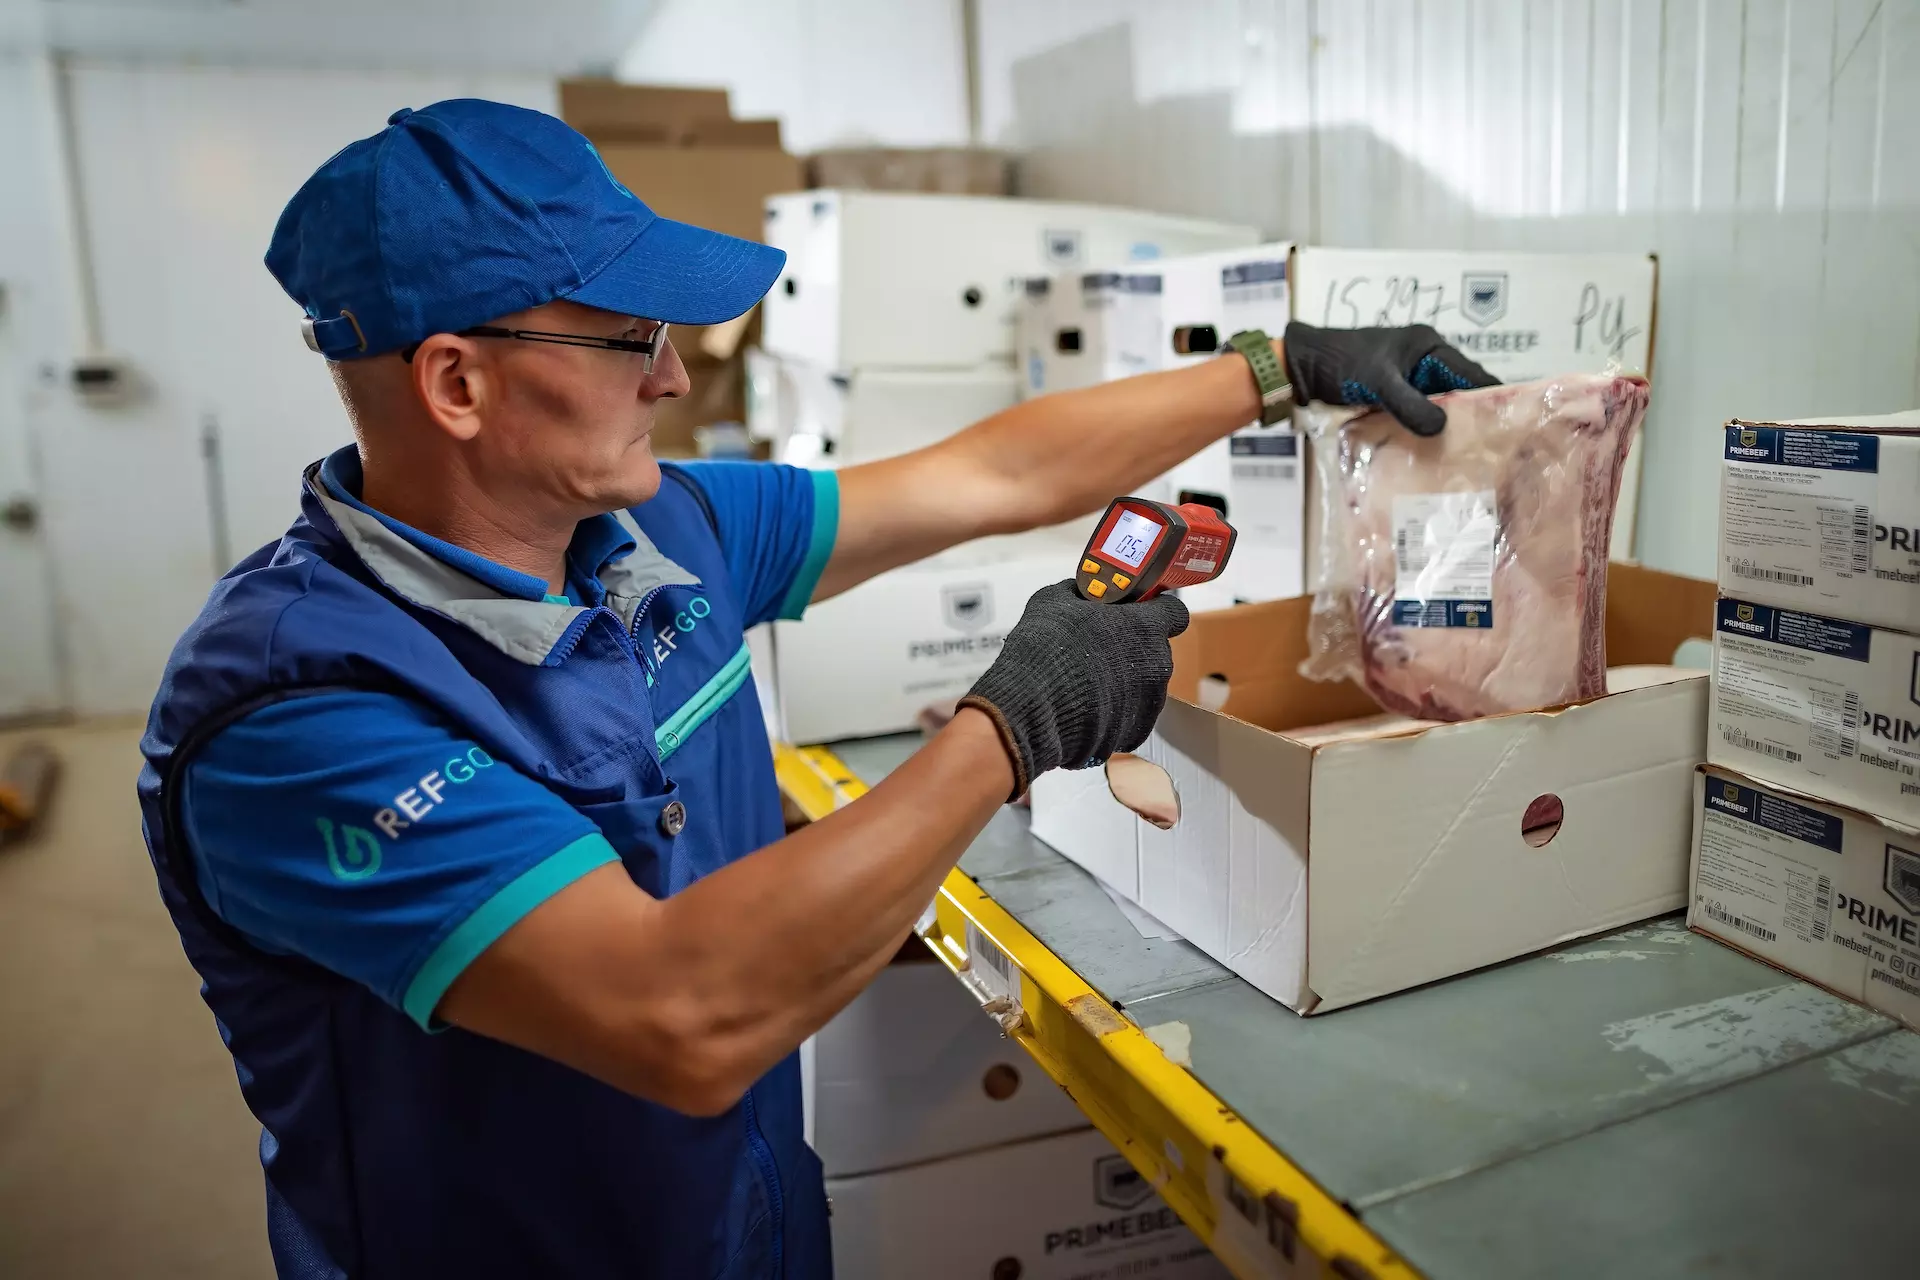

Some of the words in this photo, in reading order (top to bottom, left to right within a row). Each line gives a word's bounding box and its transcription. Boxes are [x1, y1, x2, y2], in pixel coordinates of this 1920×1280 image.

[1449, 330, 1539, 353] MEBEEF
[1729, 446, 1769, 457] PRIMEBEEF
[652, 597, 711, 669] EFGO
[1724, 618, 1765, 633] PRIMEBEEF
[372, 746, 494, 839] REFGO
[1711, 796, 1748, 813] PRIMEBEEF
